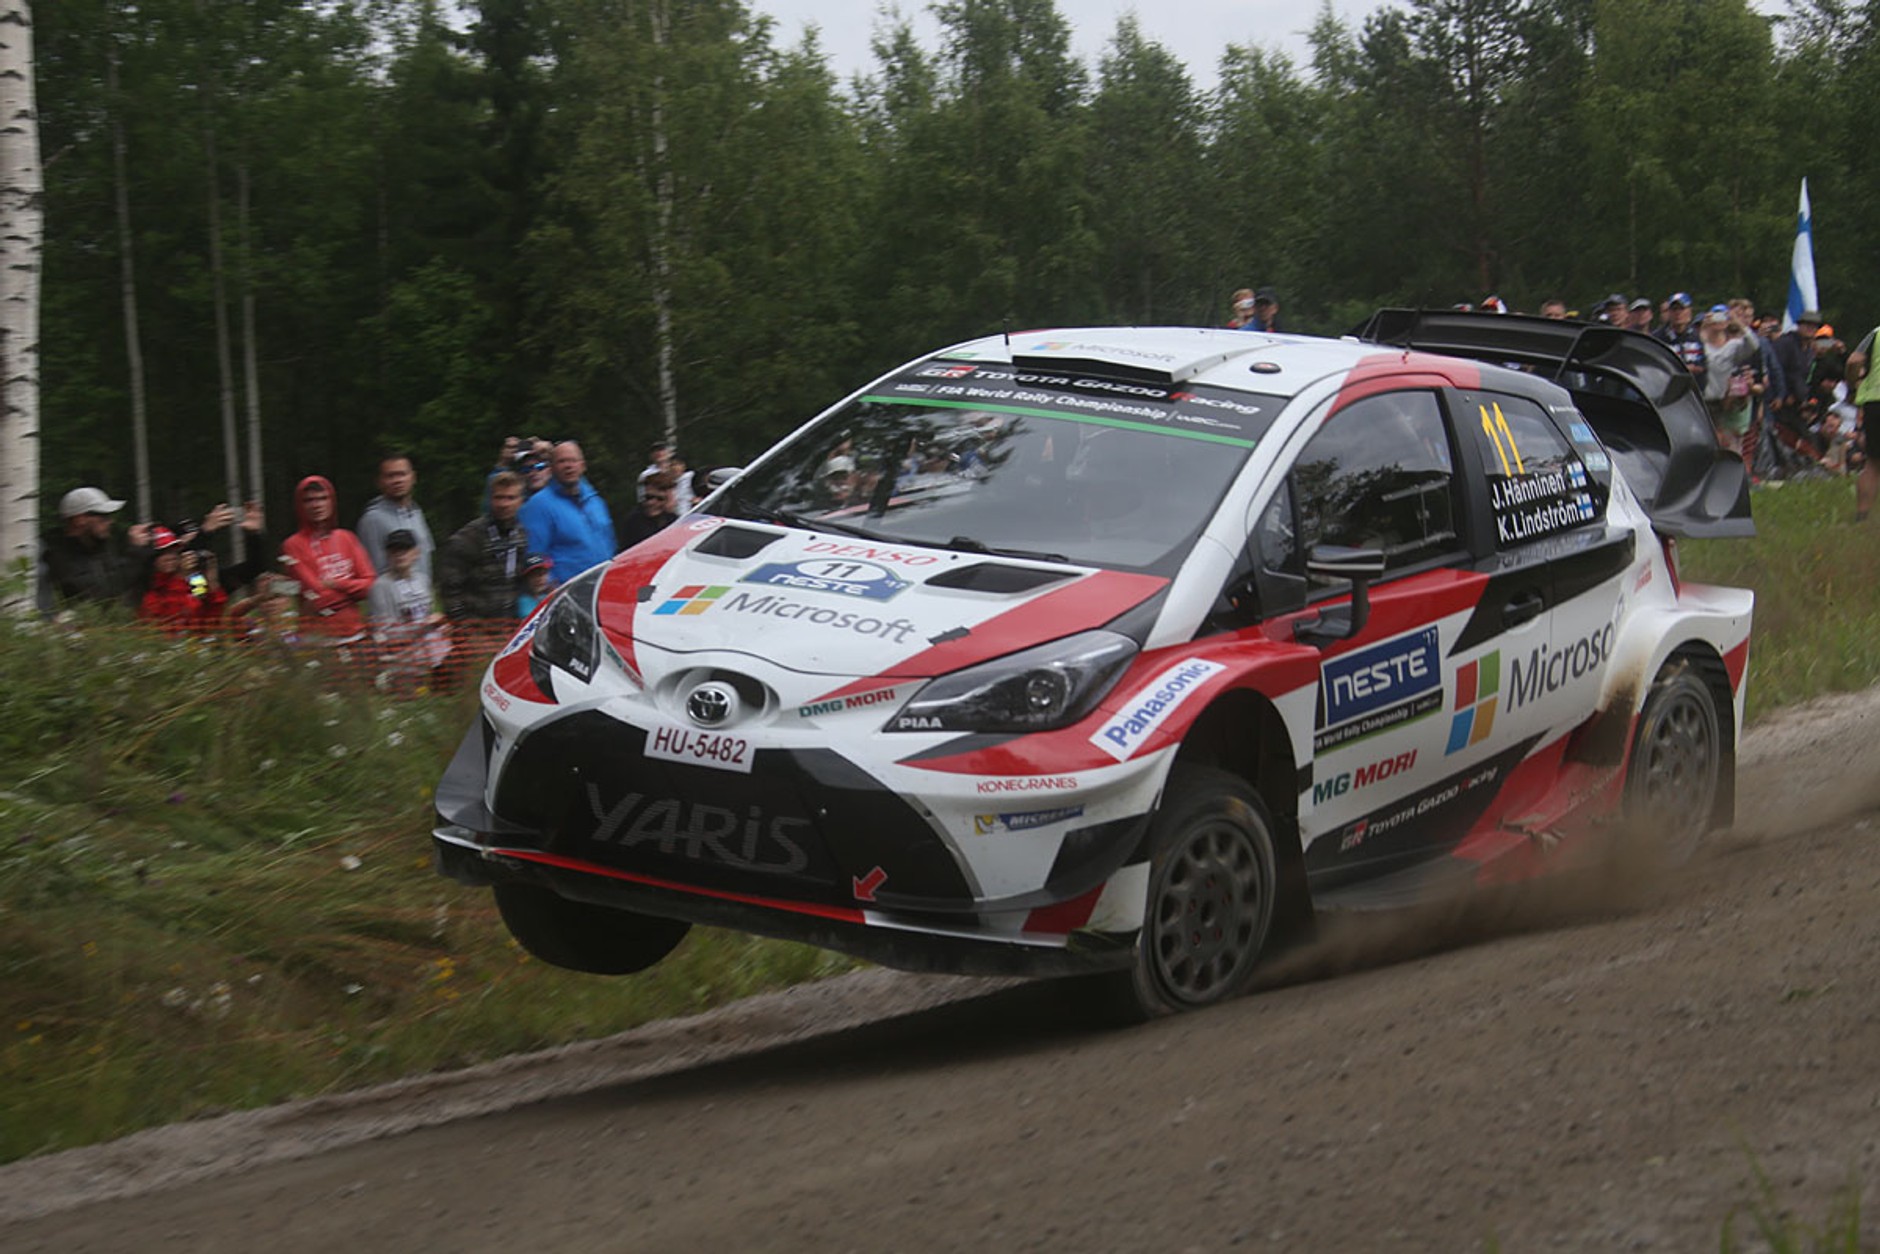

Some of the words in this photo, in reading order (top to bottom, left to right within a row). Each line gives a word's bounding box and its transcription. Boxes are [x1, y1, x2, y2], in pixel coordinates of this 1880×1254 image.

[1070, 342, 1177, 363] Microsoft
[936, 385, 965, 395] FIA
[966, 387, 1014, 399] World
[1013, 391, 1053, 404] Rally
[1055, 396, 1168, 421] Championship
[974, 370, 1070, 385] TOYOTA
[1073, 379, 1168, 398] GAZOO
[1169, 391, 1262, 415] Racing
[1479, 401, 1525, 478] 11
[1491, 470, 1566, 510] J.Hänninen
[1497, 500, 1580, 543] K.Lindström
[803, 541, 939, 567] DENSO
[820, 562, 856, 580] 11
[723, 592, 917, 645] Microsoft
[1506, 594, 1624, 714] Microso
[1333, 646, 1428, 706] NESTE
[800, 700, 844, 719] DMG
[846, 688, 896, 709] MORI
[899, 716, 943, 729] PIAA
[1103, 662, 1212, 748] Panasonic
[653, 726, 748, 765] HU-5482
[976, 776, 1078, 794] KONECRANES
[1312, 772, 1351, 806] MG
[1353, 748, 1418, 790] MORI
[1368, 806, 1415, 838] TOYOTA
[1416, 785, 1459, 816] GAZOO
[1460, 766, 1498, 791] Racing
